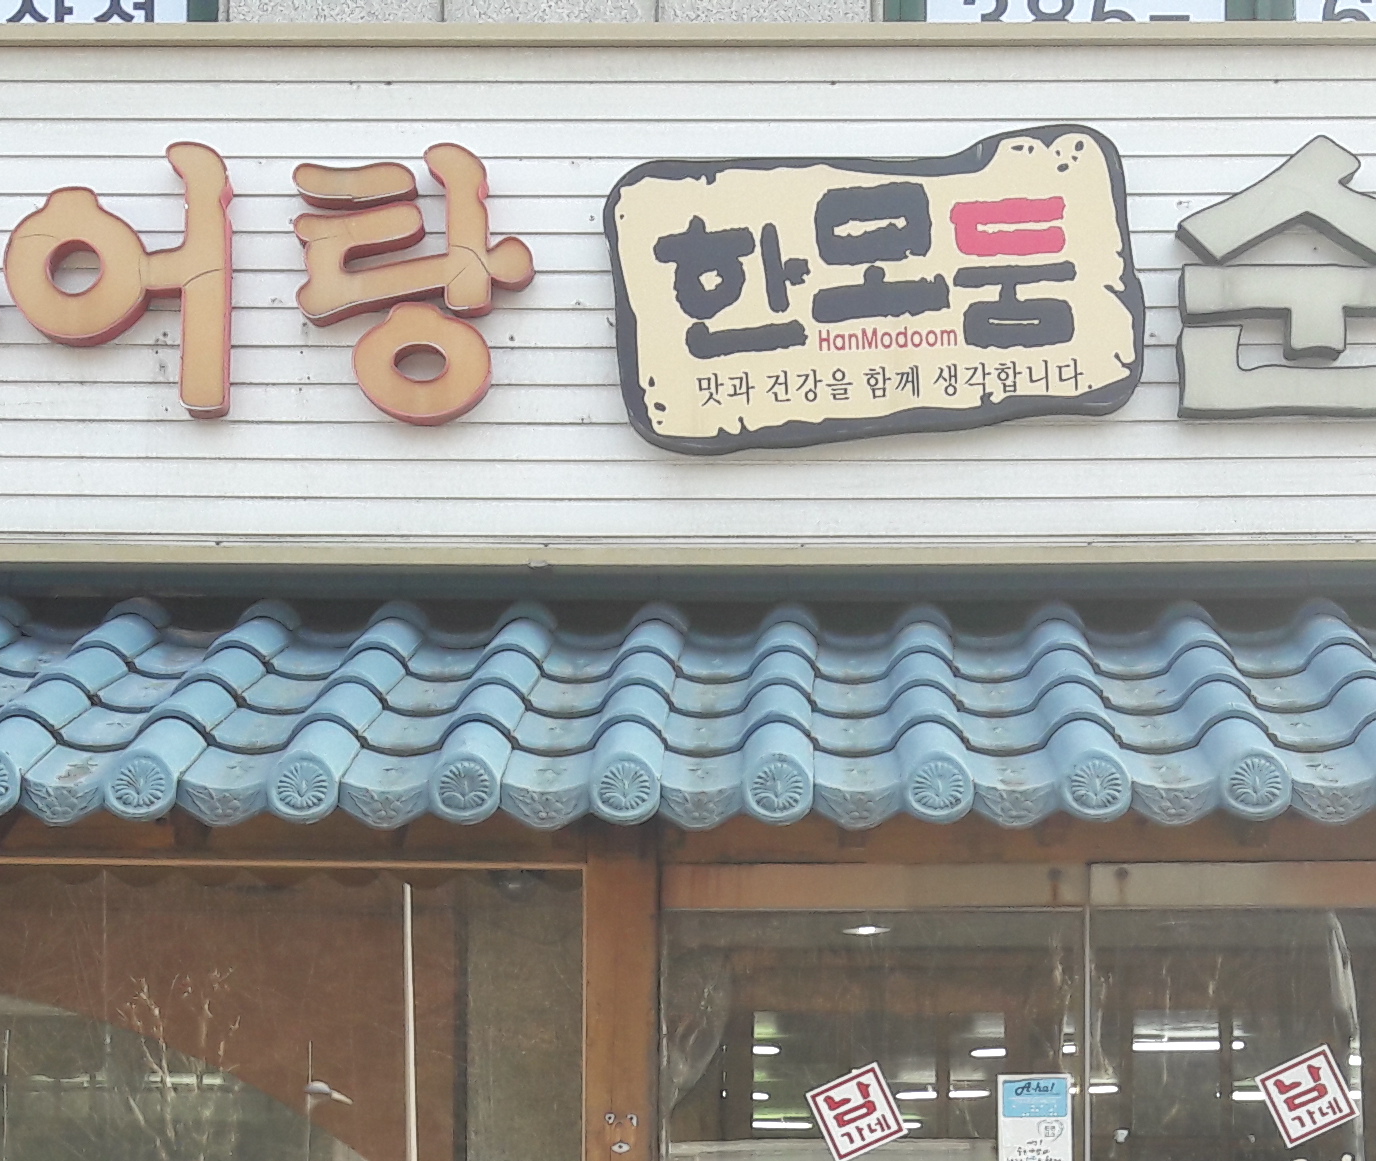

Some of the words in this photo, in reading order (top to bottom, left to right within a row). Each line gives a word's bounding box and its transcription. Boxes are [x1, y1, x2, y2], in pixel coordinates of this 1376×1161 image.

[653, 182, 1077, 360] 한모둠
[817, 327, 959, 353] HanModoom
[696, 373, 756, 407] 맛과
[765, 367, 855, 404] 건강을
[864, 365, 921, 400] 함께
[931, 357, 1093, 397] 생각합니다.
[824, 1080, 877, 1128] 남
[1272, 1063, 1328, 1111] 남
[840, 1116, 892, 1147] 가네
[1290, 1096, 1343, 1130] 가네
